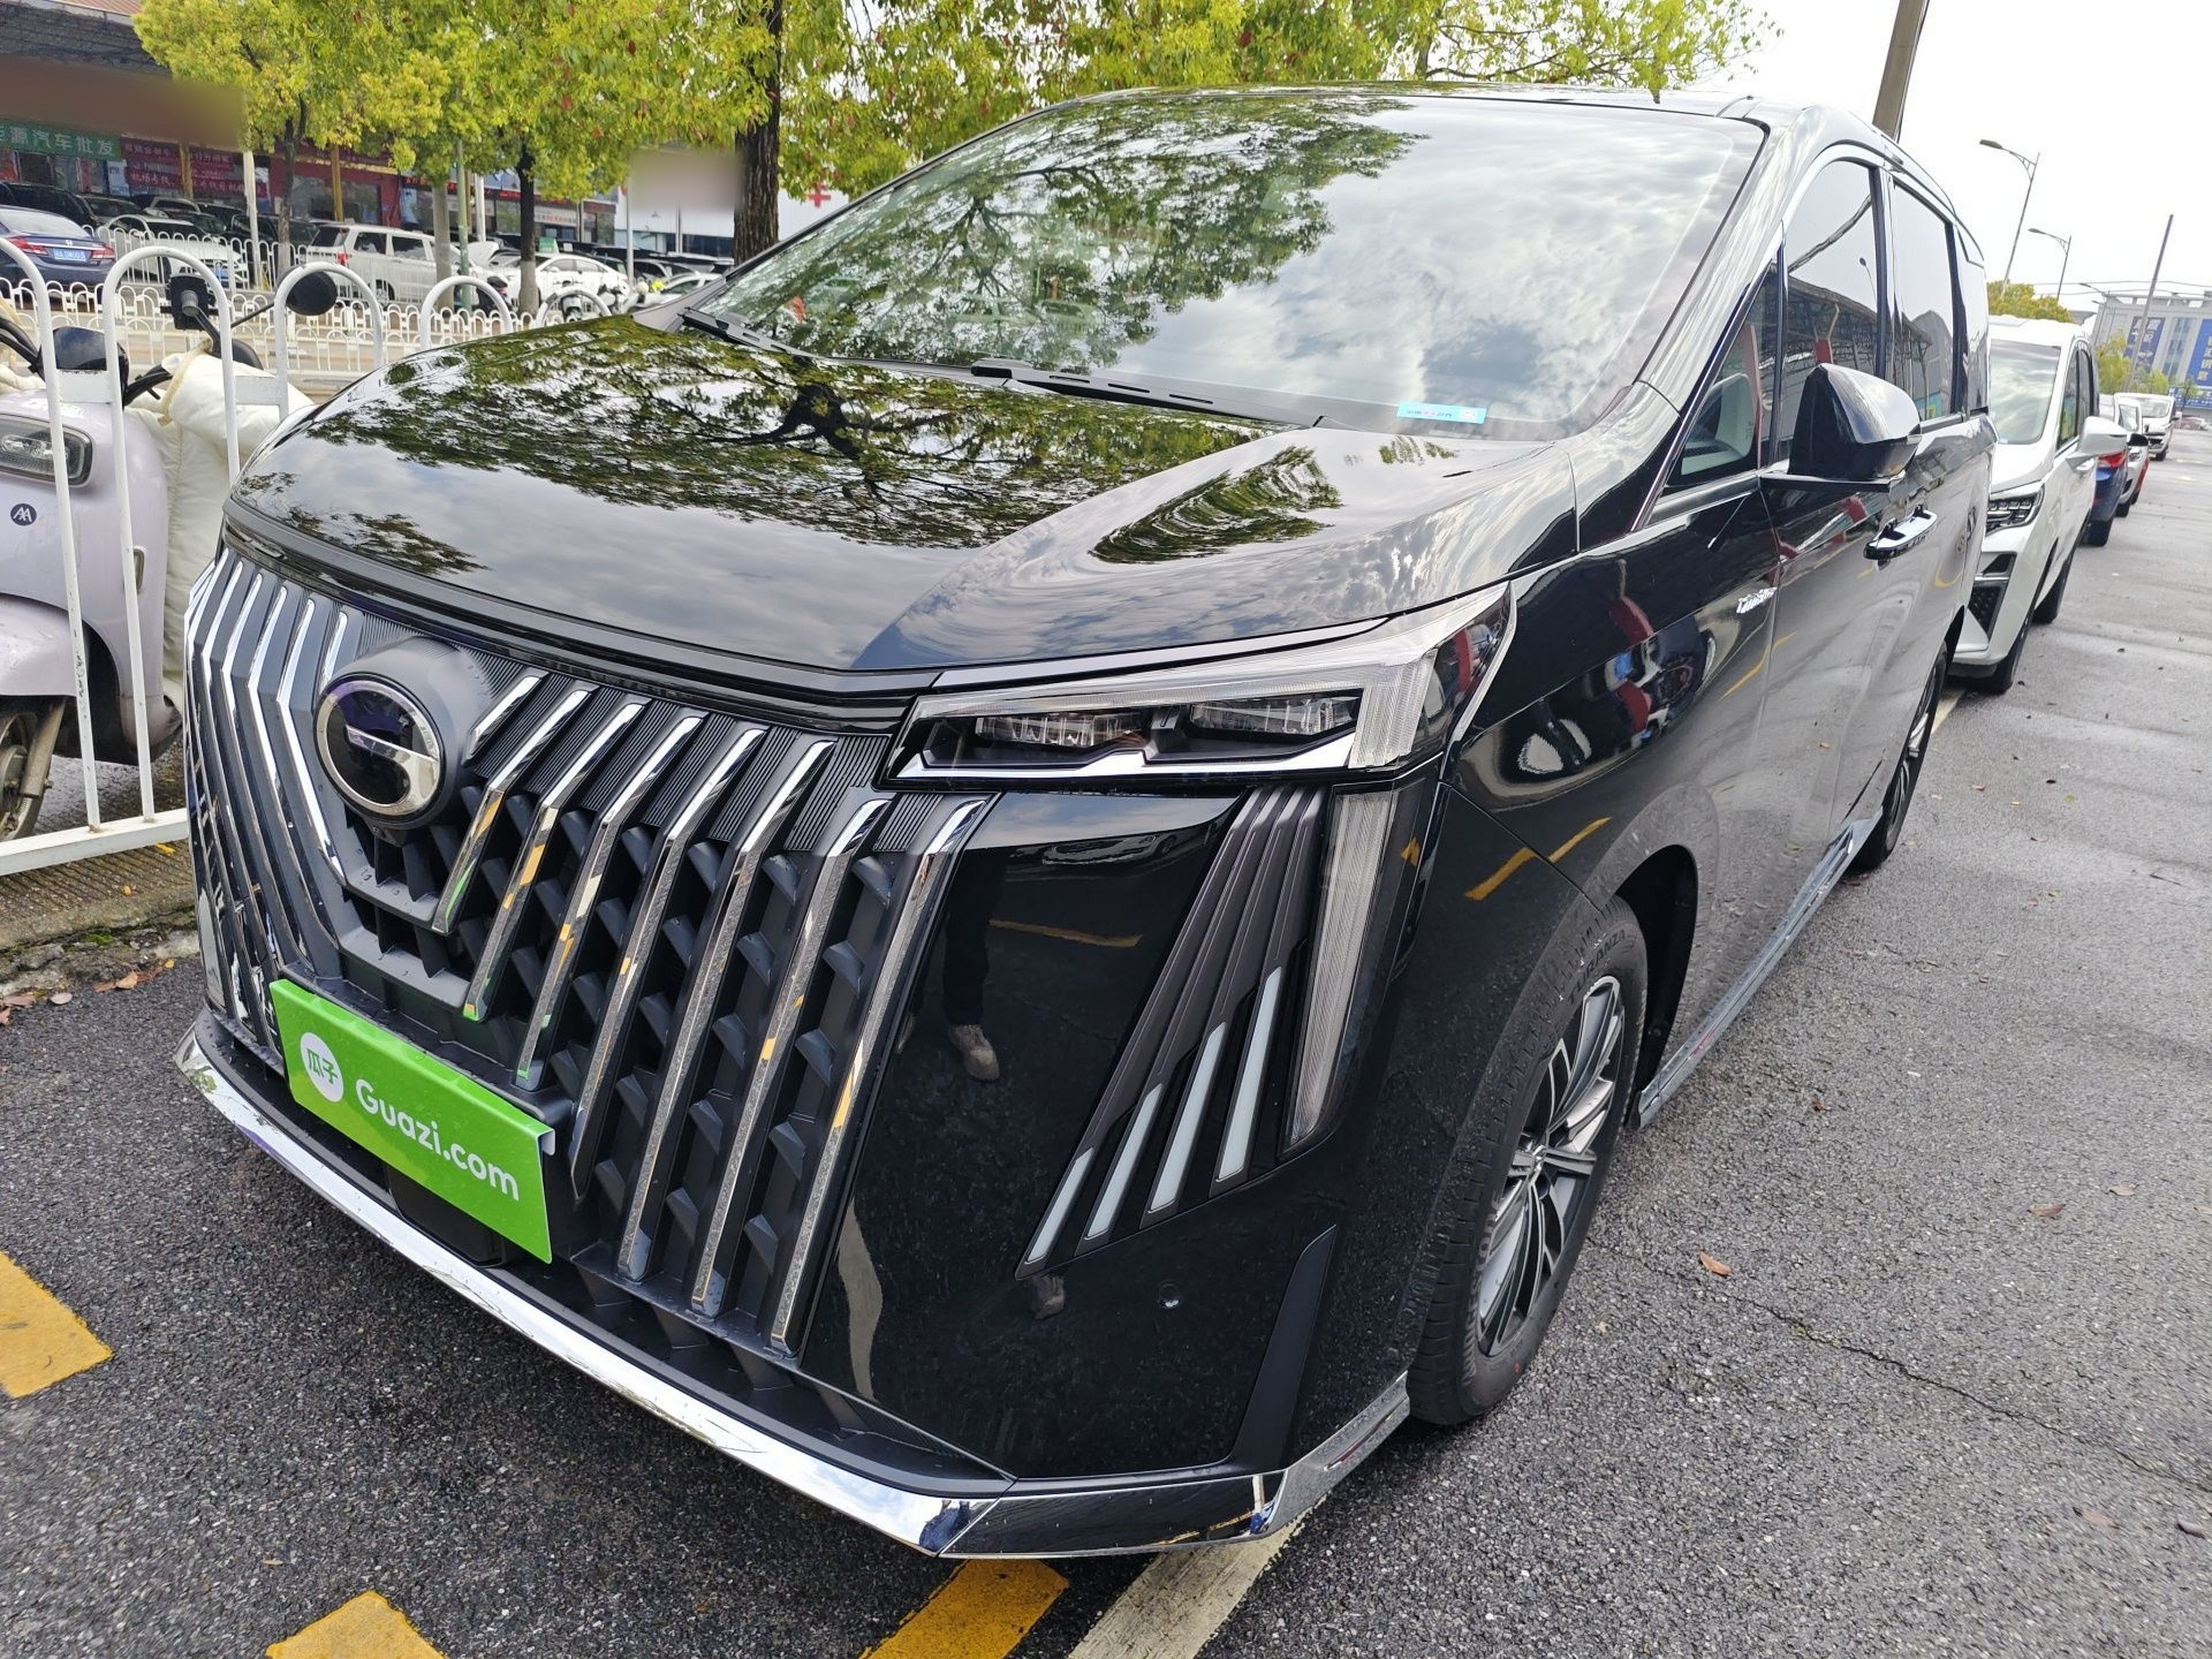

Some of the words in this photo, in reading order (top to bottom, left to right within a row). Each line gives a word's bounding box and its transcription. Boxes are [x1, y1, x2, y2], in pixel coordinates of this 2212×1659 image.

[1569, 929, 1625, 1005] TURANZA
[306, 1048, 338, 1085] 瓜子
[355, 1079, 519, 1200] Guazi.com
